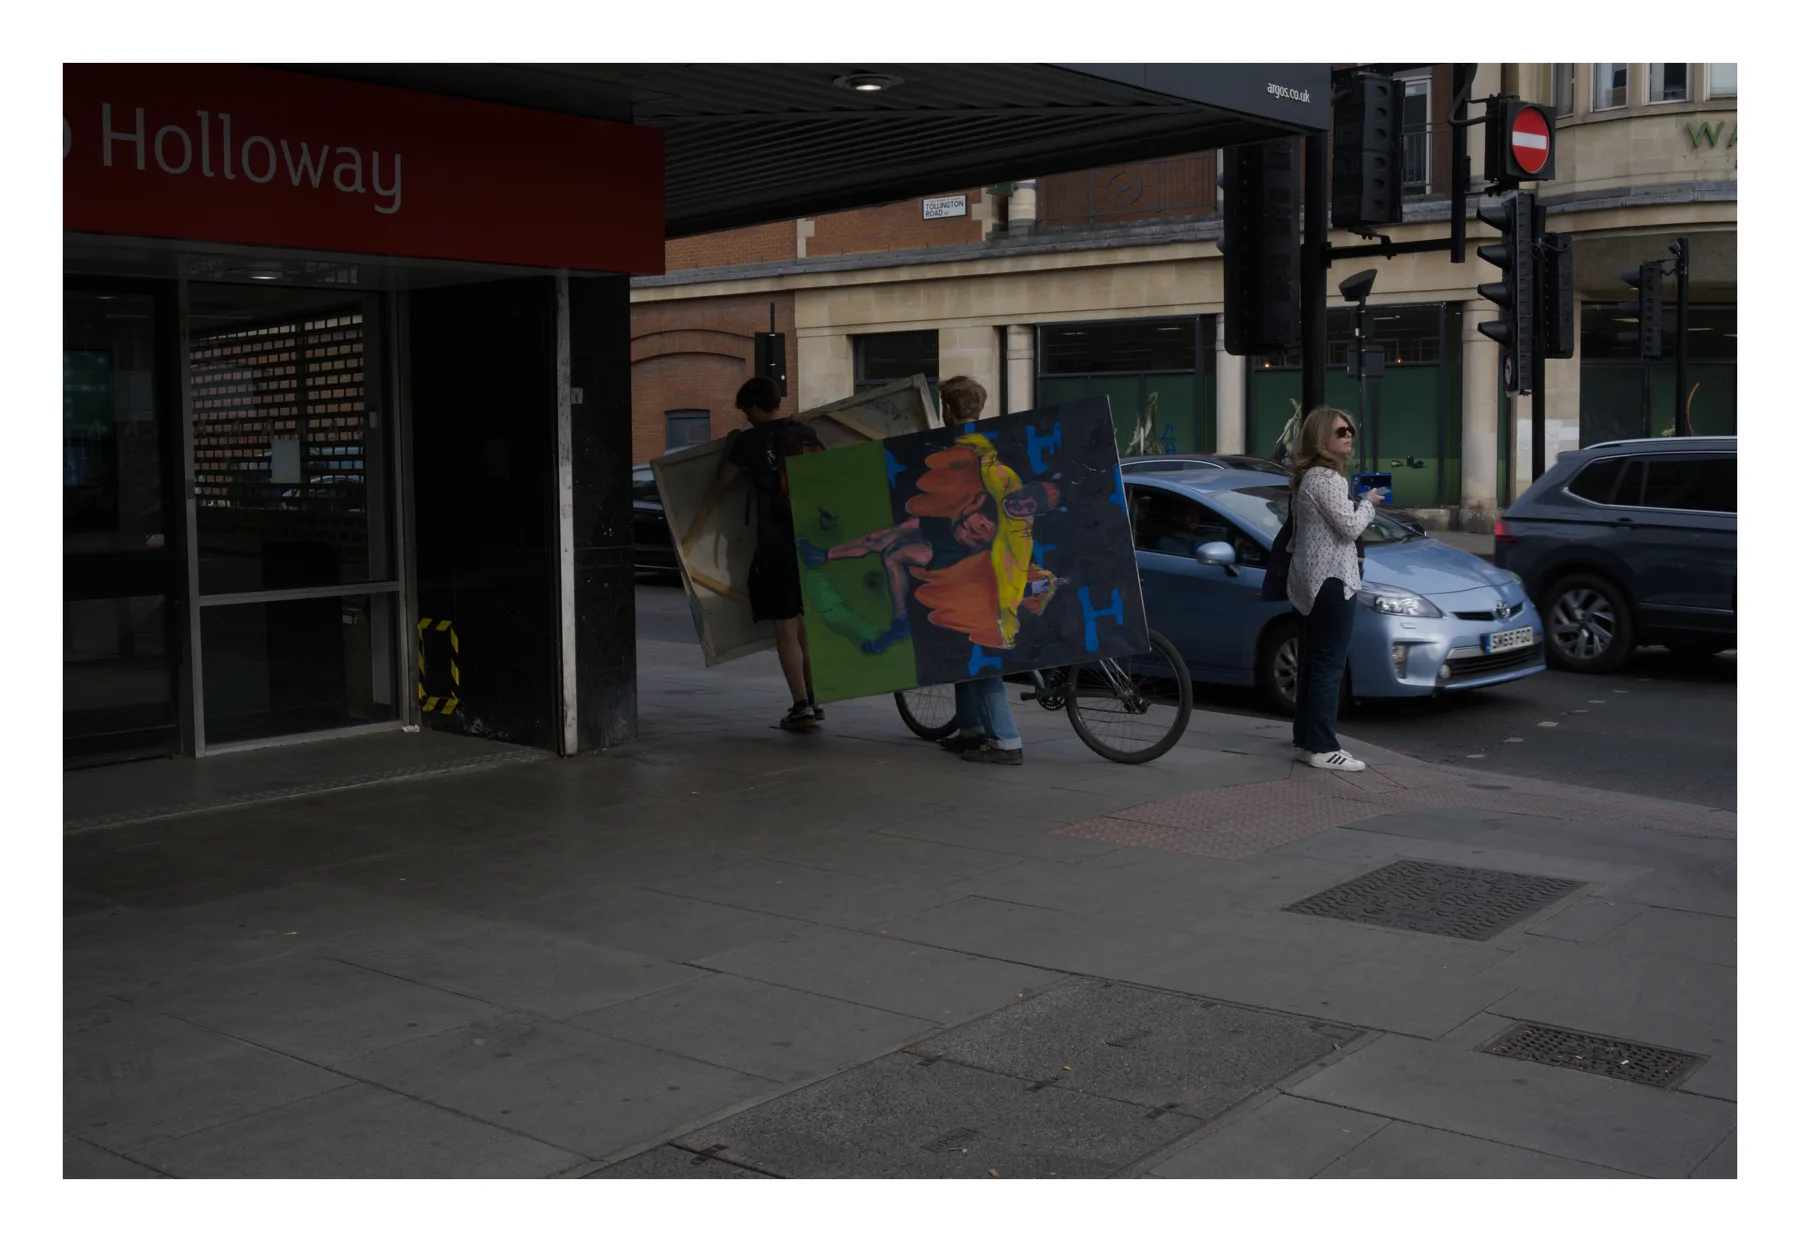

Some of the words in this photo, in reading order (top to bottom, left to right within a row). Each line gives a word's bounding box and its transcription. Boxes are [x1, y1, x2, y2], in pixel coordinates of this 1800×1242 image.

[1266, 82, 1311, 103] argos.co.uk
[100, 101, 403, 215] Holloway
[925, 200, 964, 210] TOLLINGTON
[925, 210, 943, 218] ROAD
